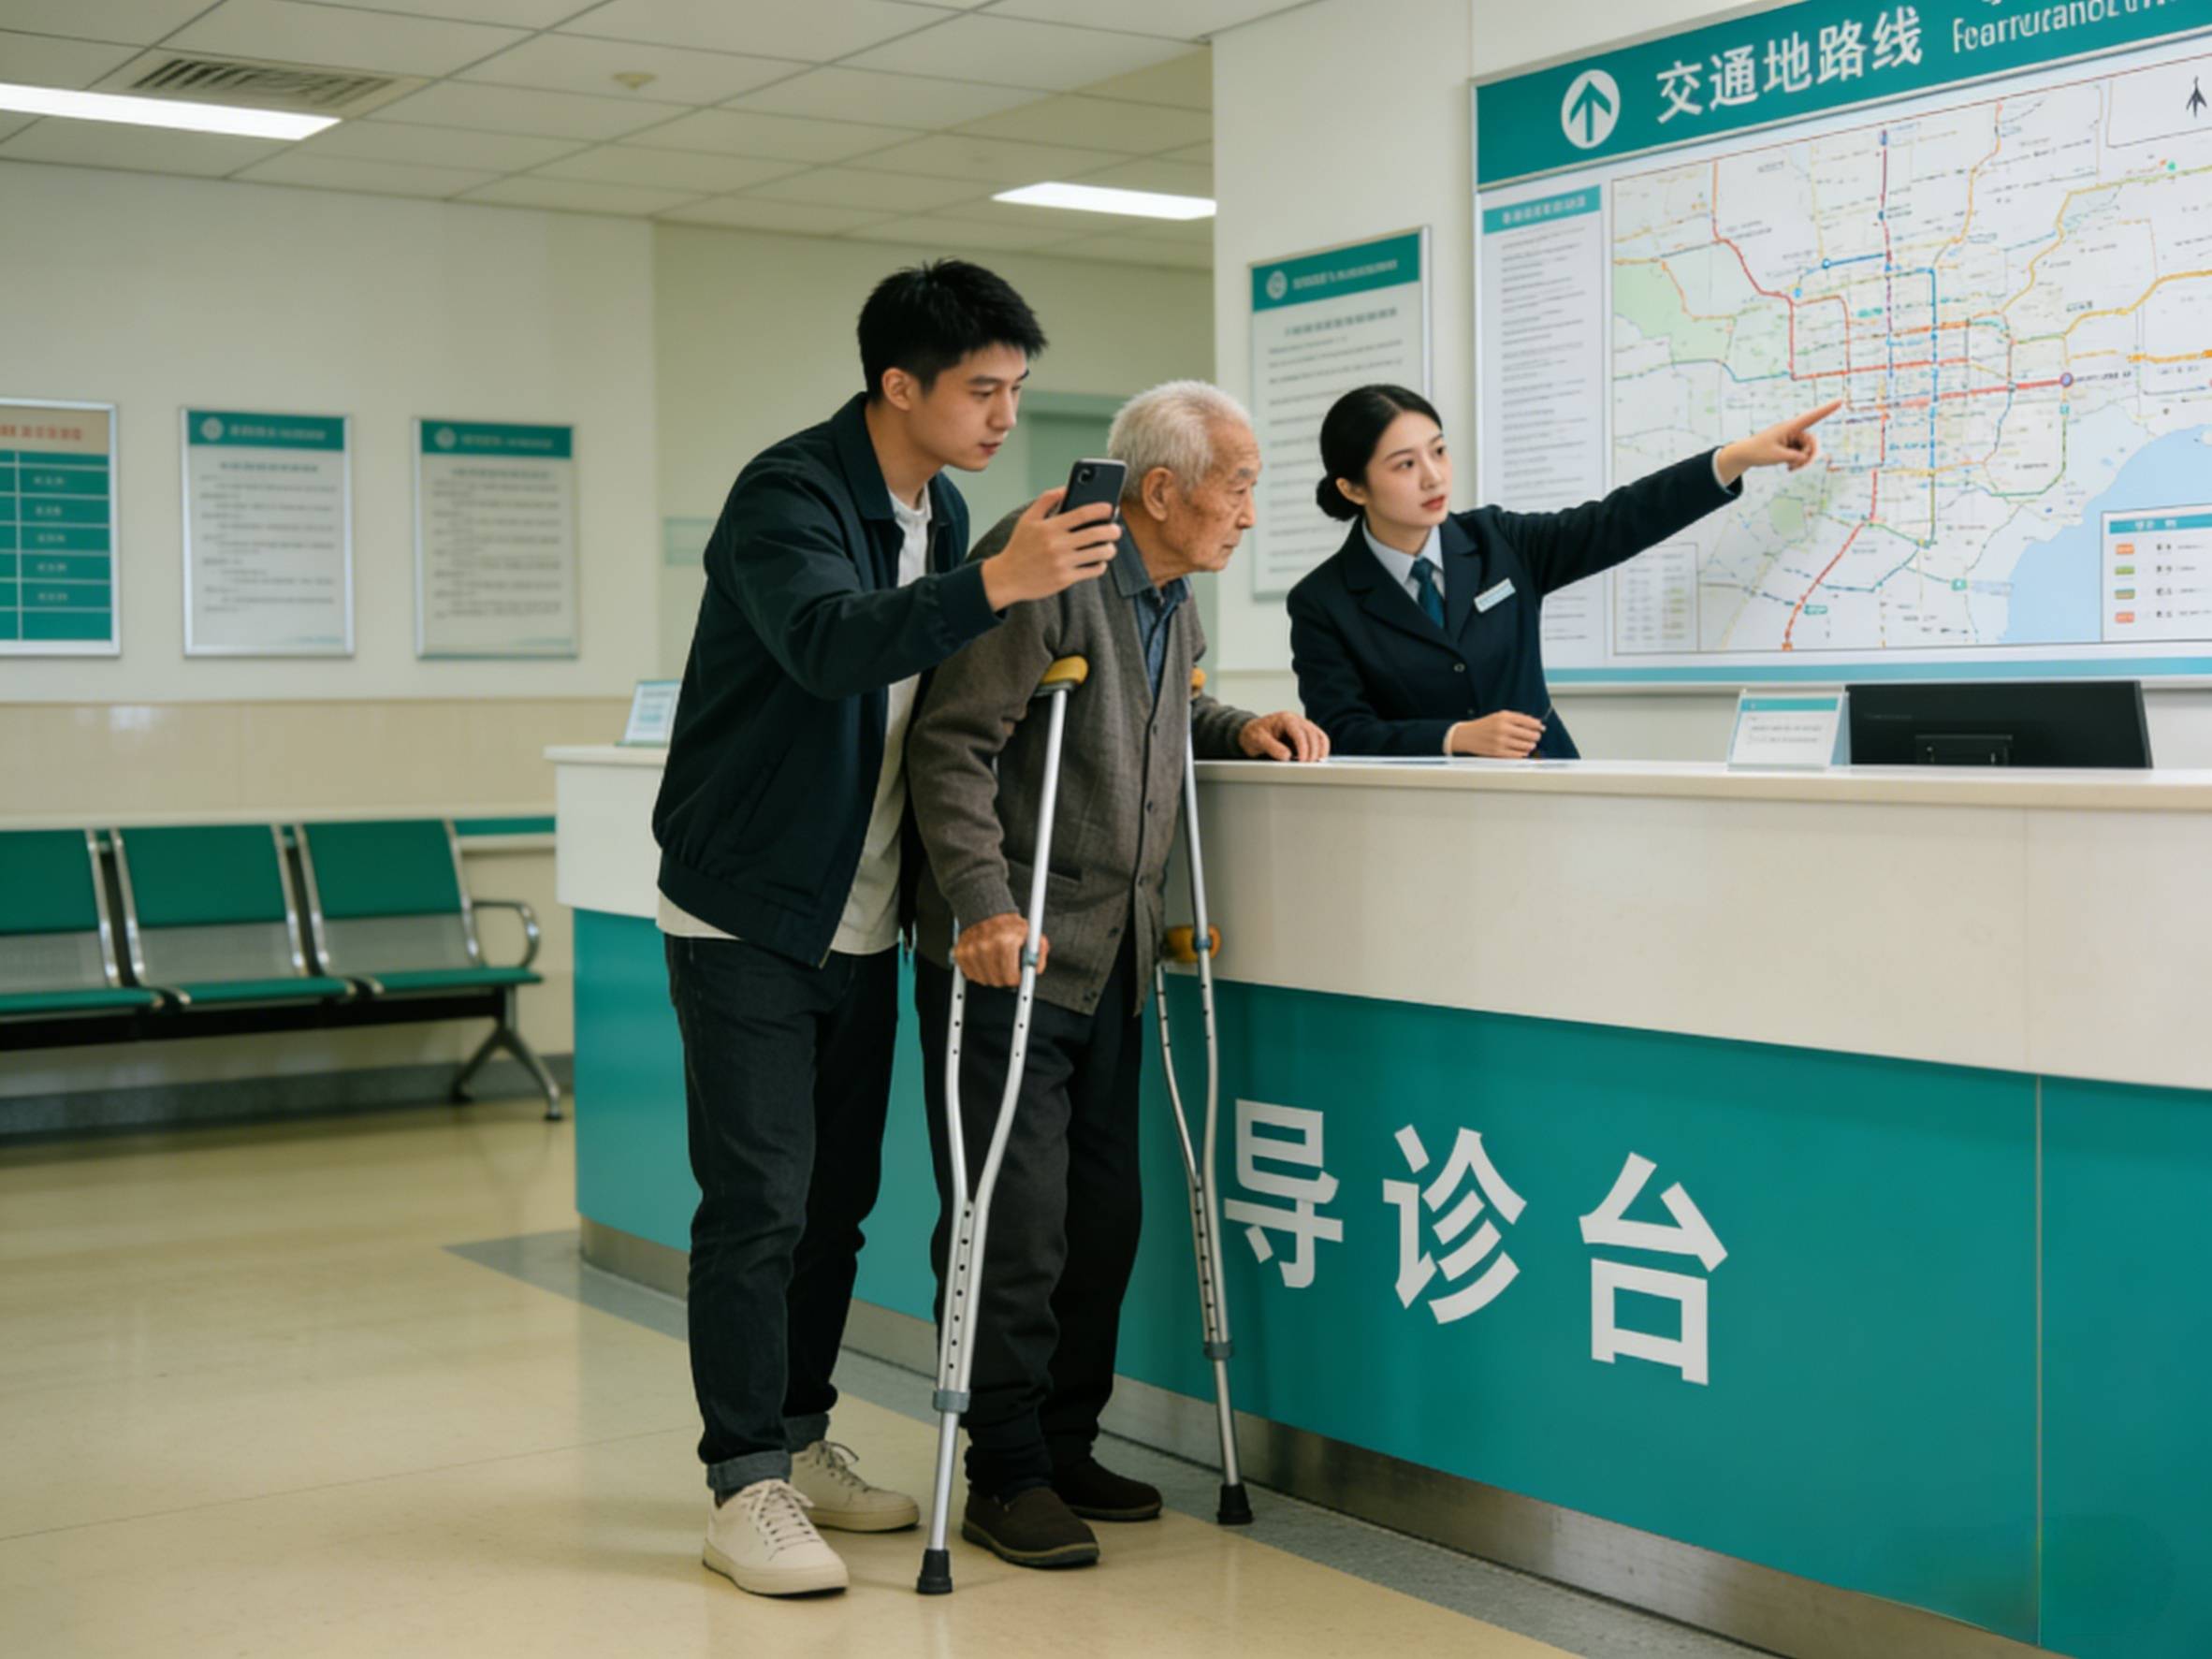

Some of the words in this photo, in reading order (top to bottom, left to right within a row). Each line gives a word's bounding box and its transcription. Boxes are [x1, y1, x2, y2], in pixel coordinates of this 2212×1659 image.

[1656, 6, 1923, 124] 交通地路线
[1224, 1099, 1728, 1386] 导诊台
